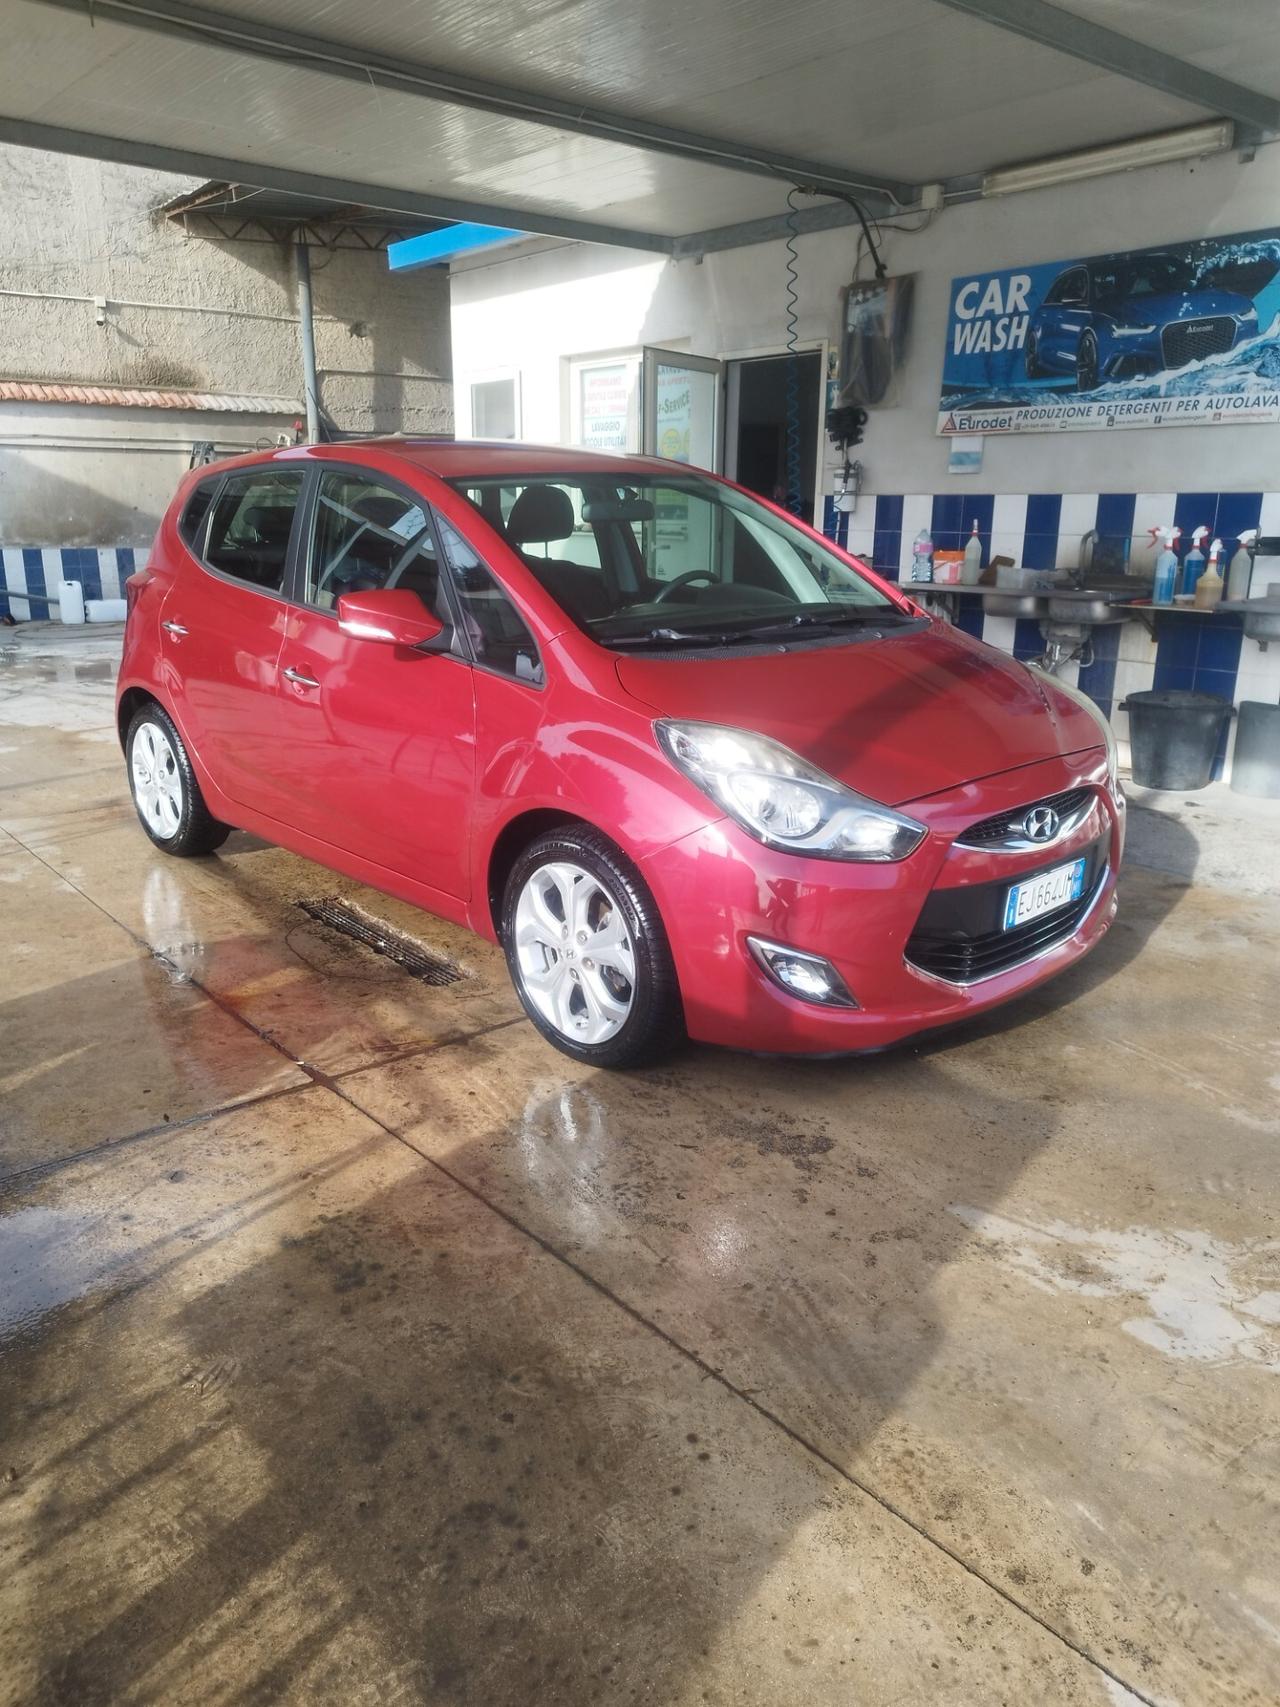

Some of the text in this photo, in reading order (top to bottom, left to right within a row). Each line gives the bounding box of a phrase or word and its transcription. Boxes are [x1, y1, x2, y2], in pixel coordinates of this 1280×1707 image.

[955, 274, 1031, 319] CAR
[954, 315, 1030, 355] WASH
[958, 415, 1013, 431] Eurodet
[1015, 406, 1094, 421] PRODUZIONE
[1097, 401, 1172, 417] DETERGENTI
[1176, 399, 1200, 412] PER
[1204, 395, 1279, 410] AUTOLAVA
